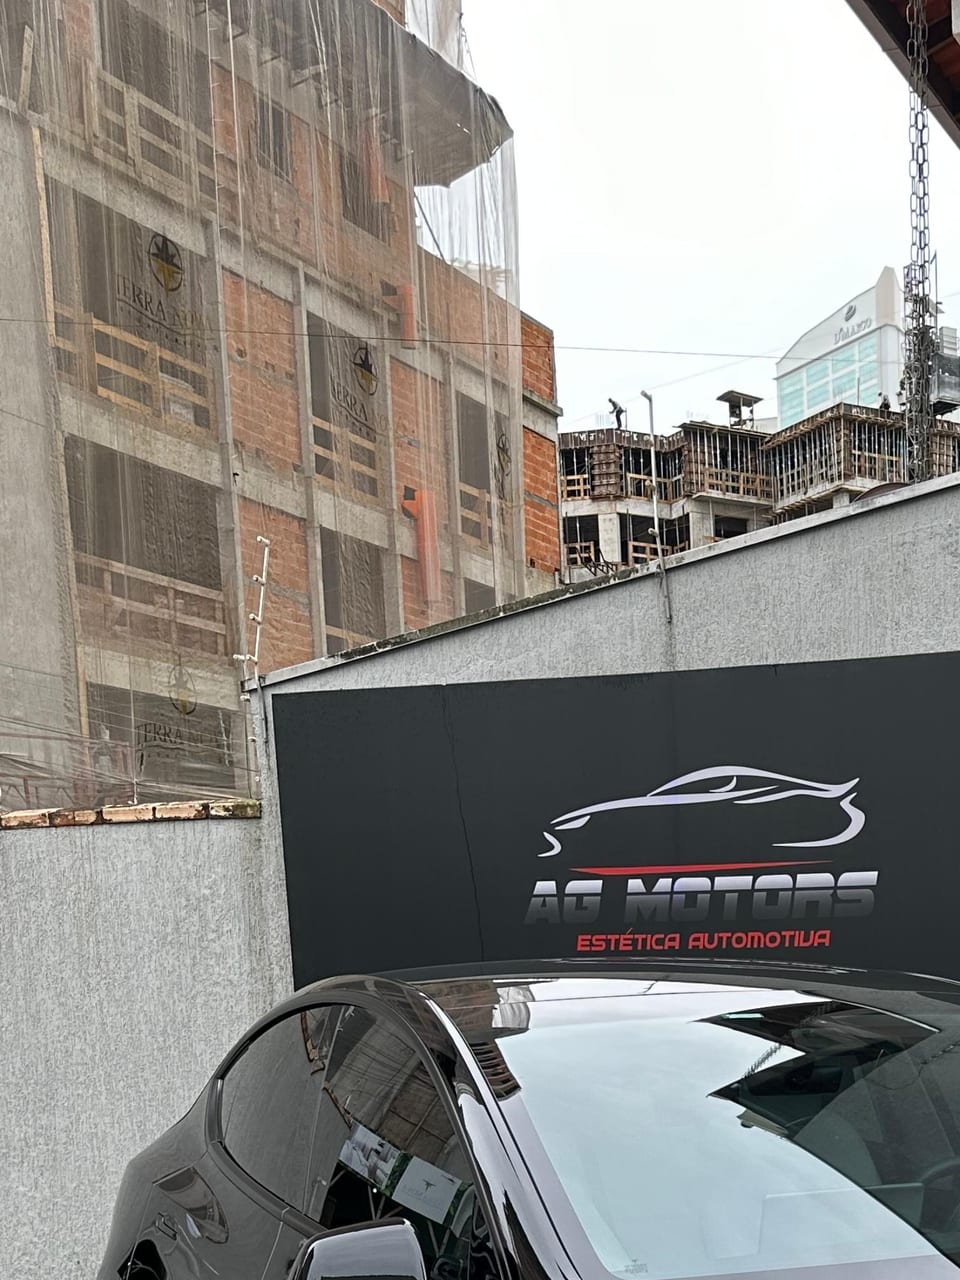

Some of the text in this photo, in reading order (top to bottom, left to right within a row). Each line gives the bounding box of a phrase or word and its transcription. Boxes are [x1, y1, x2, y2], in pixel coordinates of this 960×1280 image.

[523, 870, 879, 925] AG MOTORS
[576, 927, 831, 952] ESTÉTICA AUTOMOTIVA
